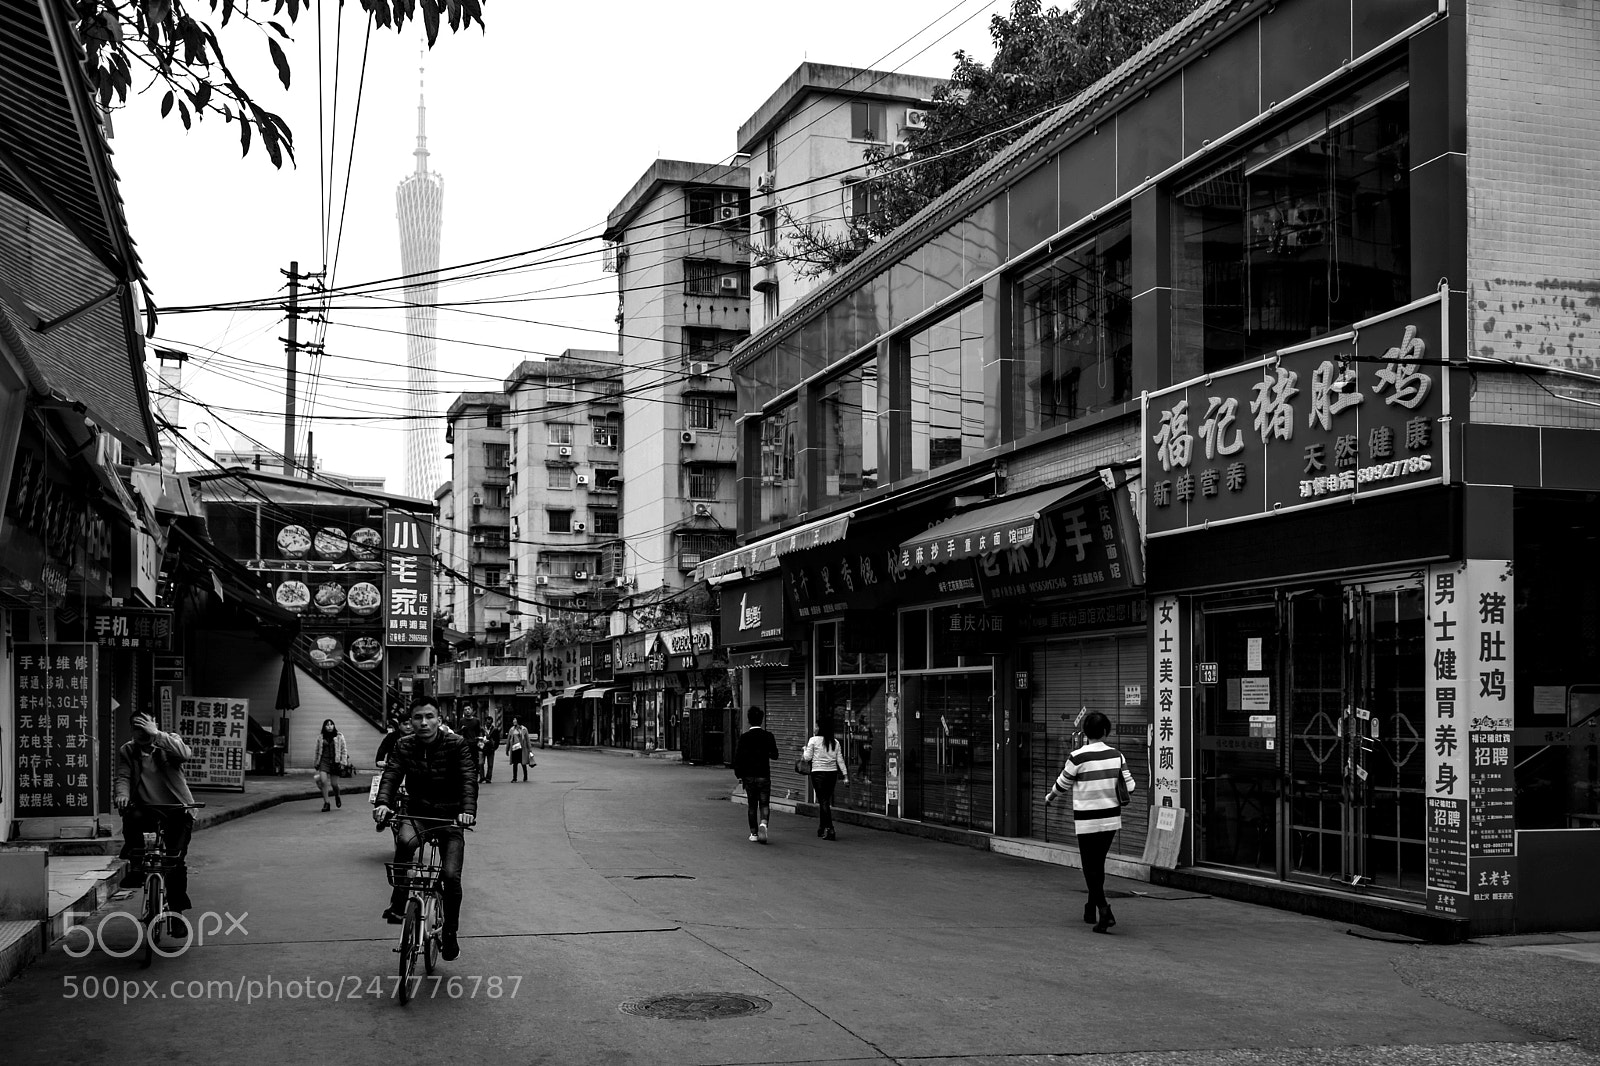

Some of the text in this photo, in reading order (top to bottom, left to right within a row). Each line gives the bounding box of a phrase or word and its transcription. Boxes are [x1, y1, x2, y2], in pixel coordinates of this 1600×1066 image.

[1152, 323, 1435, 472] 福记猪肚鸡
[1302, 417, 1433, 474] 天然健康
[1152, 462, 1247, 506] 新鲜营养
[1299, 470, 1356, 498] 订餐电话
[901, 528, 1017, 567] 老麻抄手重庆面馆
[391, 521, 420, 617] 小毛家
[419, 592, 429, 617] 饭店
[94, 615, 169, 639] 手机维修
[949, 613, 1004, 633] 重庆小面
[1478, 591, 1507, 702] 猪肚鸡
[20, 655, 89, 671] 手机维修
[20, 675, 89, 690] 联通、移动、电信
[1158, 600, 1174, 770] 女士美容养颜
[1433, 572, 1459, 796] 男士健胃养身
[20, 695, 89, 710] 套卡4G、3G上号
[20, 714, 89, 730] 无线网卡
[20, 734, 89, 749] 充电宝、蓝牙
[19, 753, 89, 769] 内存卡、耳机
[1474, 746, 1509, 767] 招聘
[19, 772, 89, 789] 读卡器、U盘
[19, 792, 89, 808] 数据线、电池
[1434, 808, 1461, 828] 招聘
[1478, 870, 1512, 887] 王老吉
